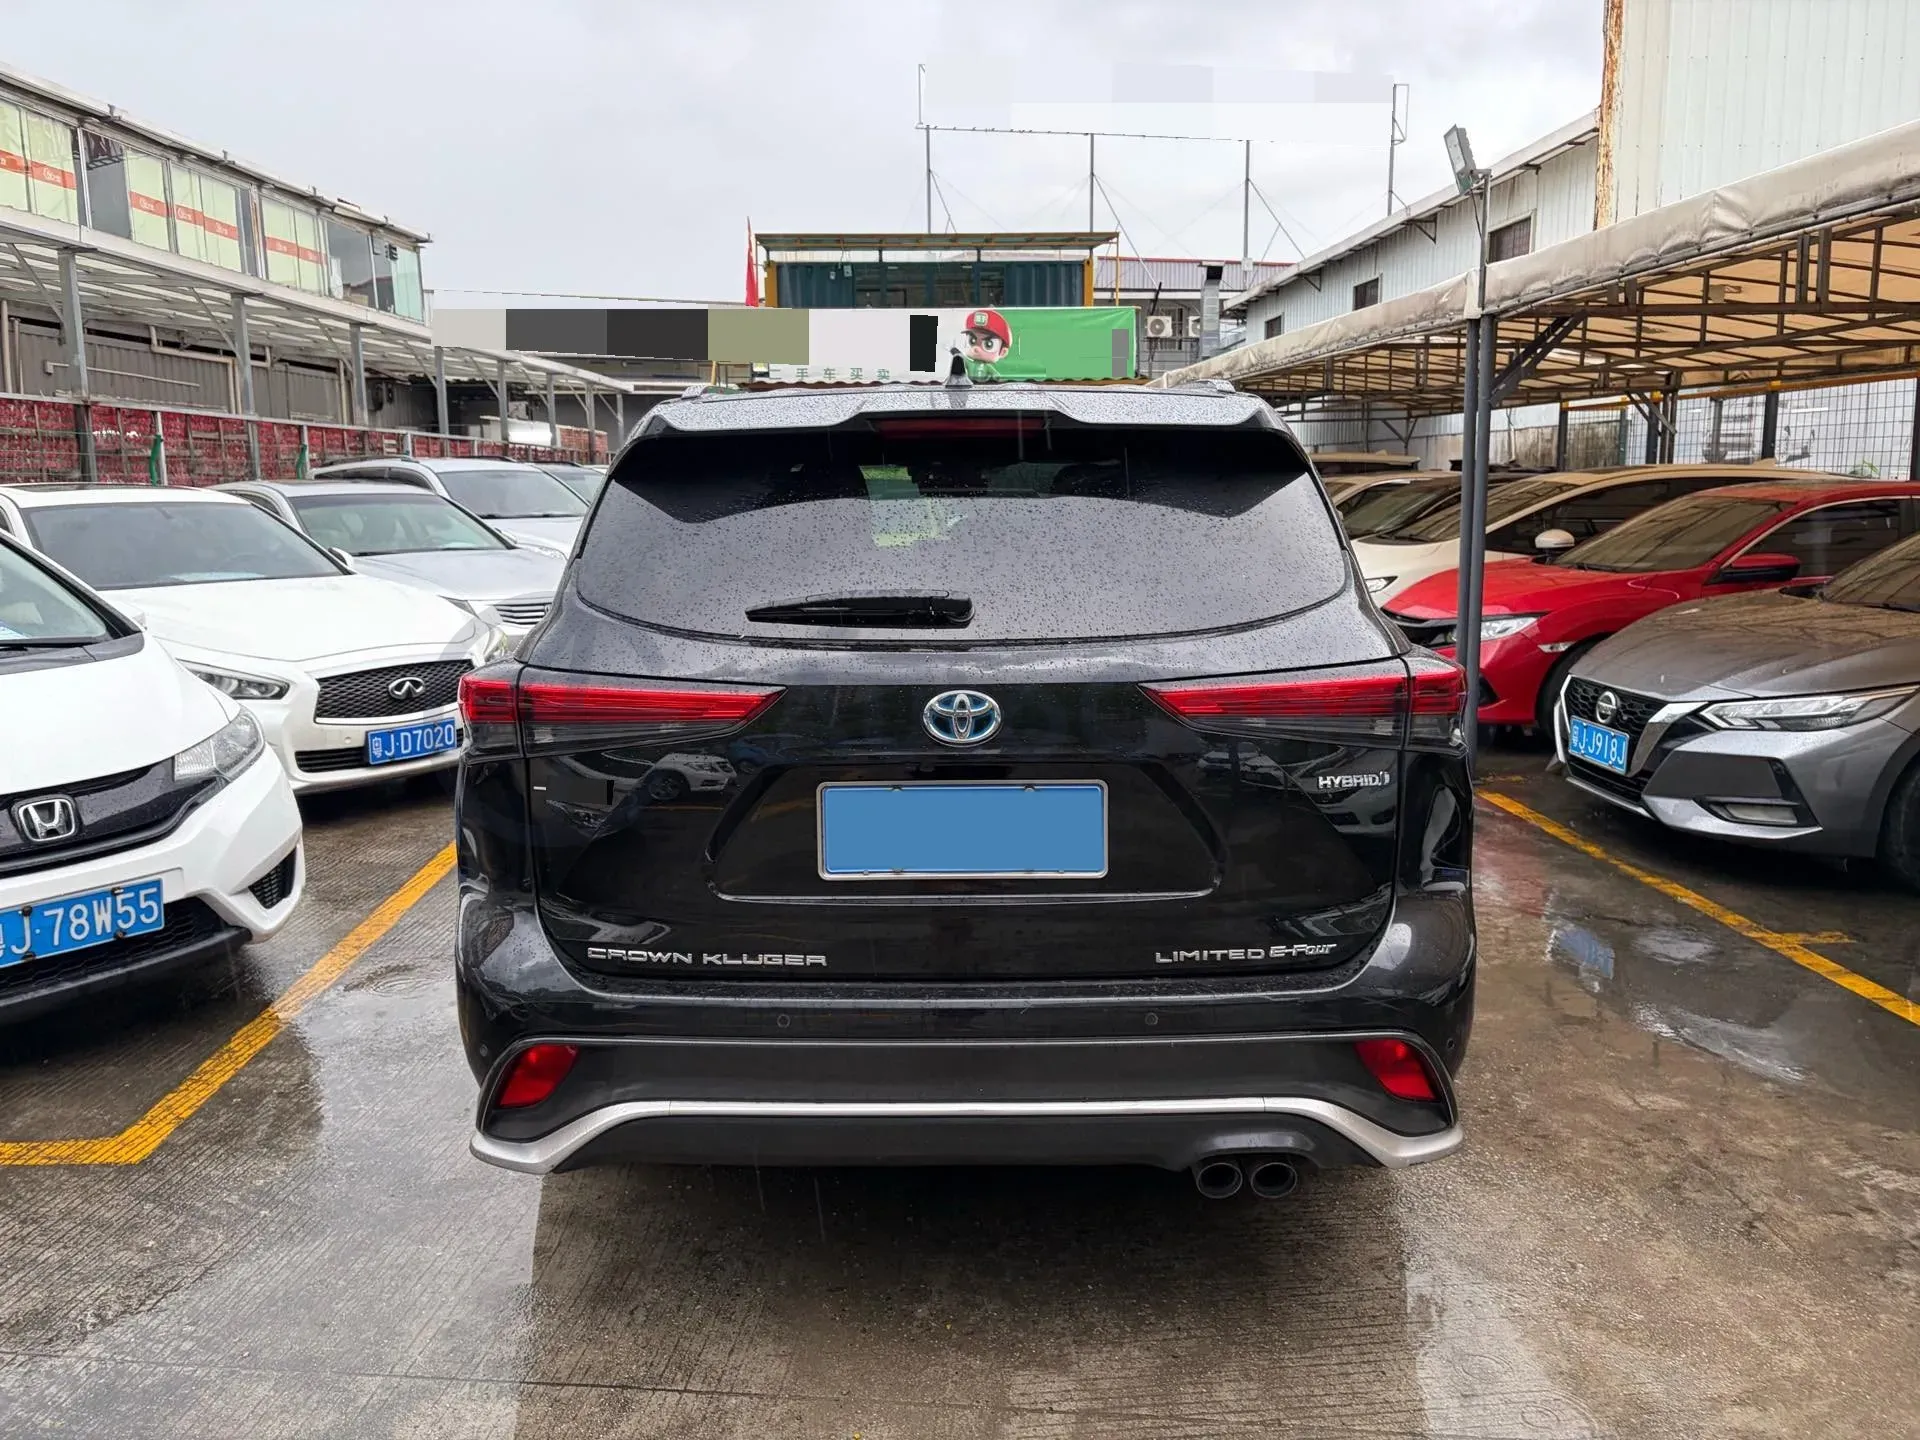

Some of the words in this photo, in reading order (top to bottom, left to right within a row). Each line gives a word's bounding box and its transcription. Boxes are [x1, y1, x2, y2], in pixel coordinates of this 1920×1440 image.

[769, 367, 890, 380] 二手车买卖
[1318, 774, 1379, 789] HYBRID
[588, 947, 693, 963] CROWN
[703, 953, 827, 966] KLUGER
[1155, 948, 1265, 964] LIMITED
[1269, 943, 1337, 958] E-Four
